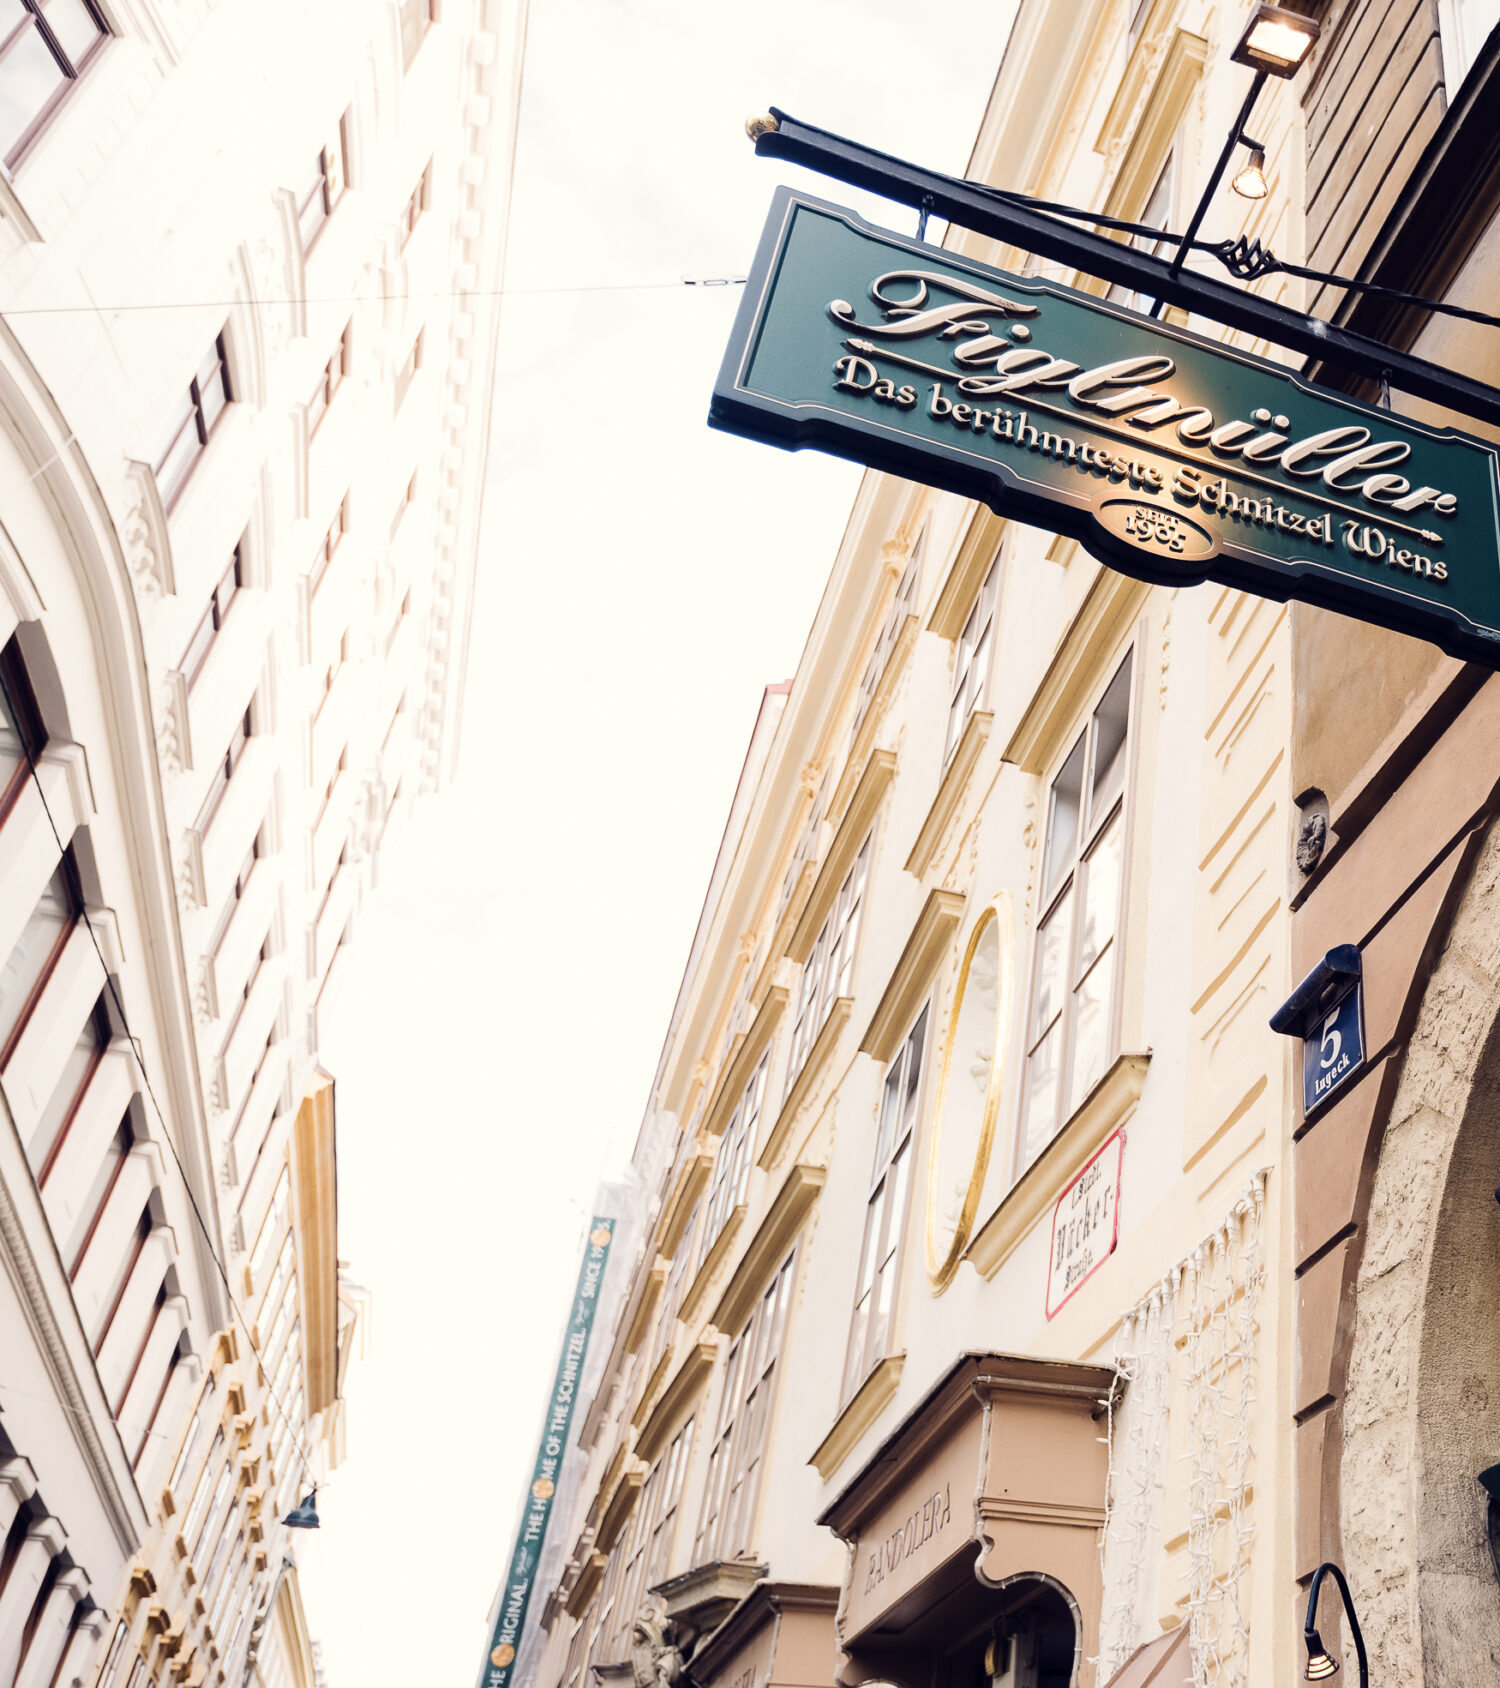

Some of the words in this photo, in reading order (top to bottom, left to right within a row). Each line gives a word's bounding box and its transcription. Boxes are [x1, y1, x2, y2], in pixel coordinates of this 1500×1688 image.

[830, 269, 1458, 514] Figlmüller
[836, 354, 918, 405] Das
[927, 382, 1165, 488] berühmteste
[1174, 464, 1336, 544] Schnitzel
[1344, 518, 1450, 581] Wiens
[1126, 515, 1187, 553] 1905
[1135, 506, 1181, 532] SEIT
[1319, 1006, 1342, 1069] 5
[1314, 1052, 1351, 1096] Lugeck
[580, 1261, 602, 1300] SINCE
[550, 1404, 570, 1433] THE
[545, 1434, 562, 1457] OF
[524, 1512, 546, 1543] THE
[863, 1481, 952, 1597] BANDOLERA
